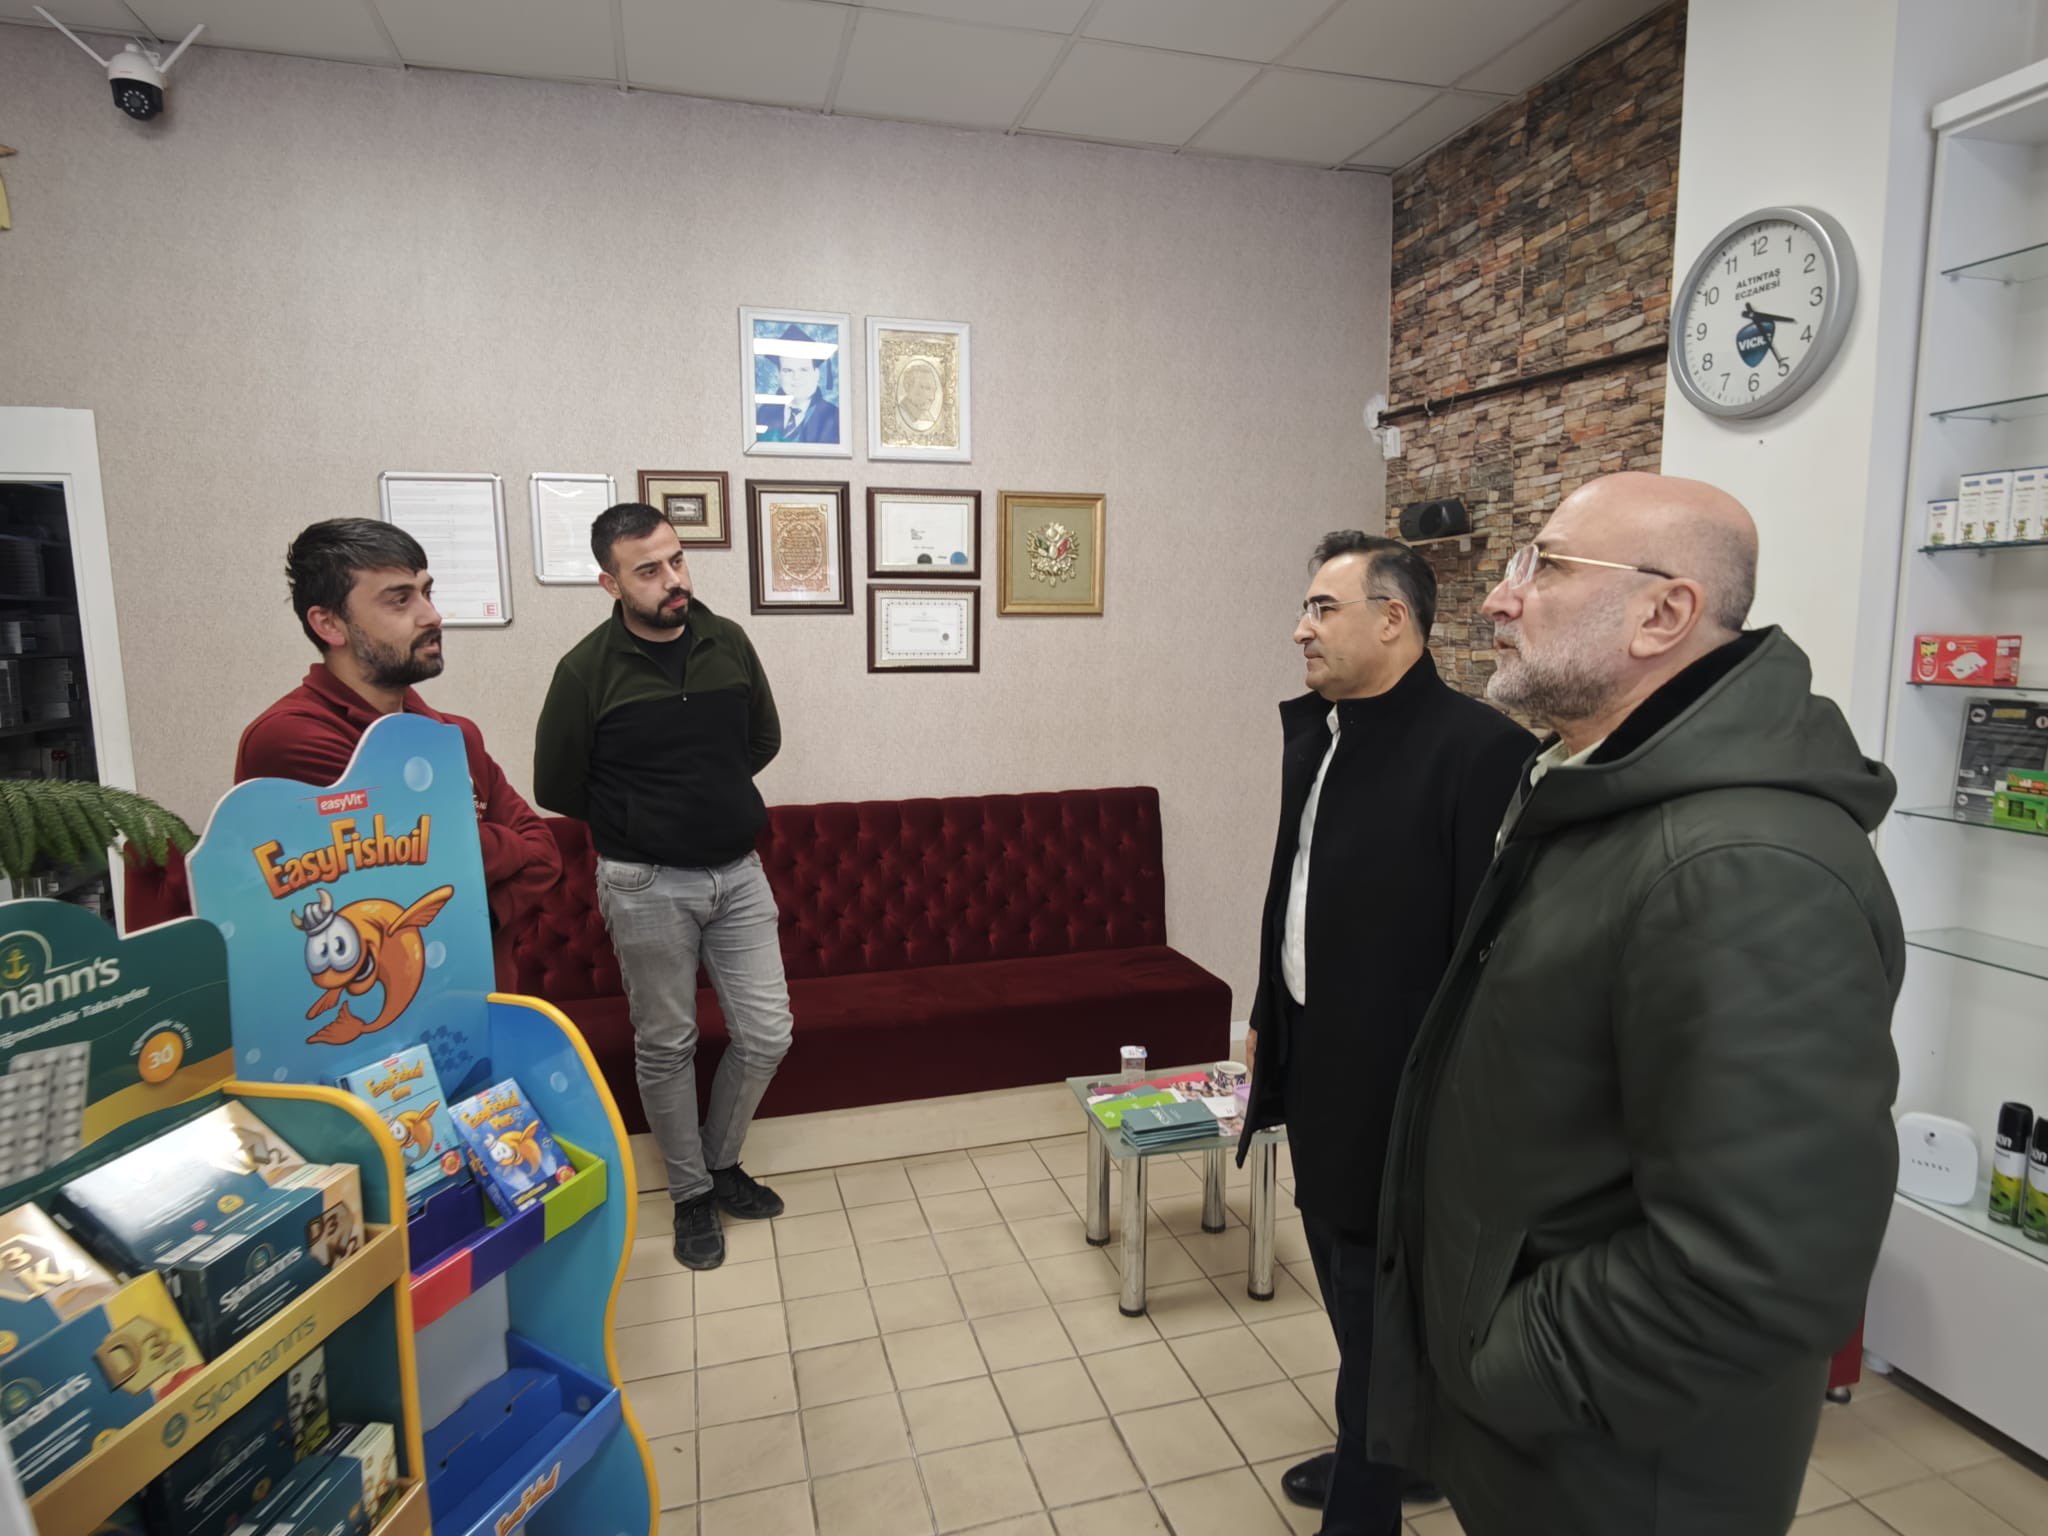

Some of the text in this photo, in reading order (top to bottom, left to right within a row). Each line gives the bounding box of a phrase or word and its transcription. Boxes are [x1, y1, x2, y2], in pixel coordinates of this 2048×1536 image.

[1751, 236, 1768, 256] 12
[1785, 235, 1792, 253] 1
[1725, 256, 1738, 275] 11
[1803, 253, 1816, 273] 2
[1703, 286, 1720, 306] 10
[1809, 286, 1823, 307] 3
[1697, 323, 1707, 341] 9
[1800, 325, 1813, 343] 4
[1702, 353, 1713, 371] 8
[1777, 356, 1790, 377] 5
[1720, 373, 1731, 391] 7
[1748, 373, 1760, 392] 6
[320, 794, 363, 812] easyVit
[252, 814, 432, 900] EasyFishoil
[147, 1043, 175, 1069] 30
